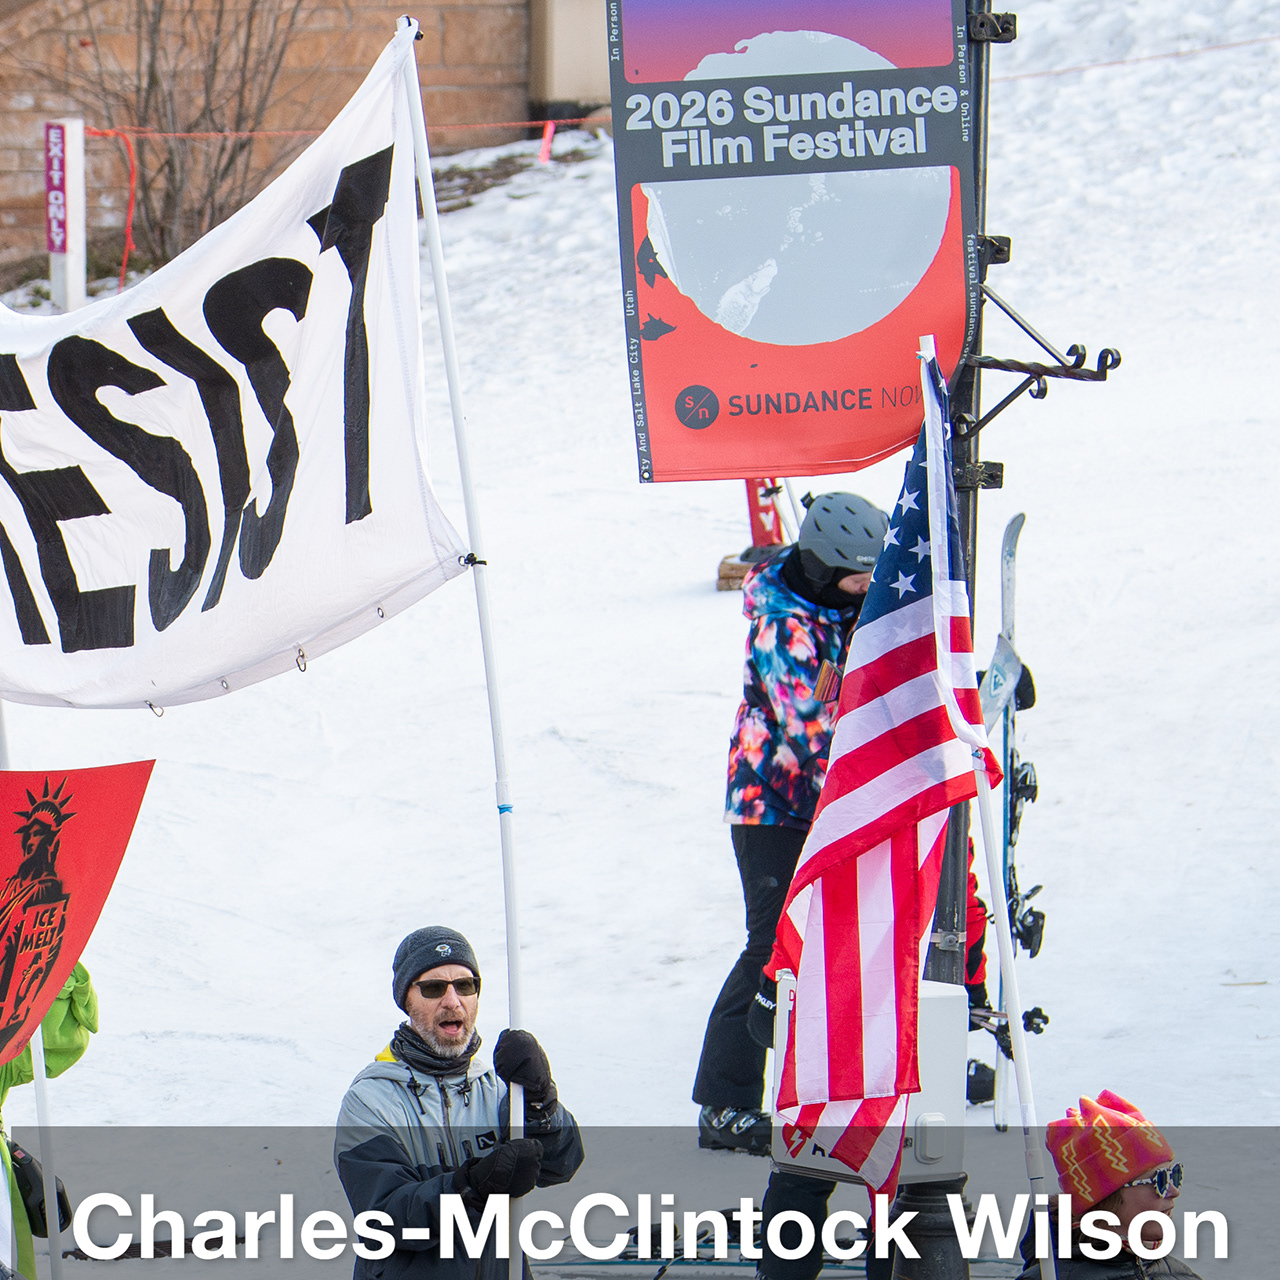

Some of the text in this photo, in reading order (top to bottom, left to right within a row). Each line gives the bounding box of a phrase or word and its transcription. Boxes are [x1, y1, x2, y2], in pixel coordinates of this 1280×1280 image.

[609, 2, 620, 61] In Person
[956, 25, 966, 38] In
[958, 44, 966, 84] Person
[626, 81, 958, 130] 2026 Sundance
[960, 102, 970, 142] Online
[661, 116, 927, 168] Film Festival
[48, 128, 65, 248] EXIT ONLY
[625, 289, 634, 317] Utah
[958, 233, 978, 365] festival.sundance.org
[629, 337, 639, 364] City
[632, 369, 641, 395] Lake
[635, 401, 644, 427] Salt
[728, 387, 872, 417] SUNDANCE
[639, 432, 648, 452] And
[33, 906, 57, 929] ICE
[19, 927, 57, 954] MELT
